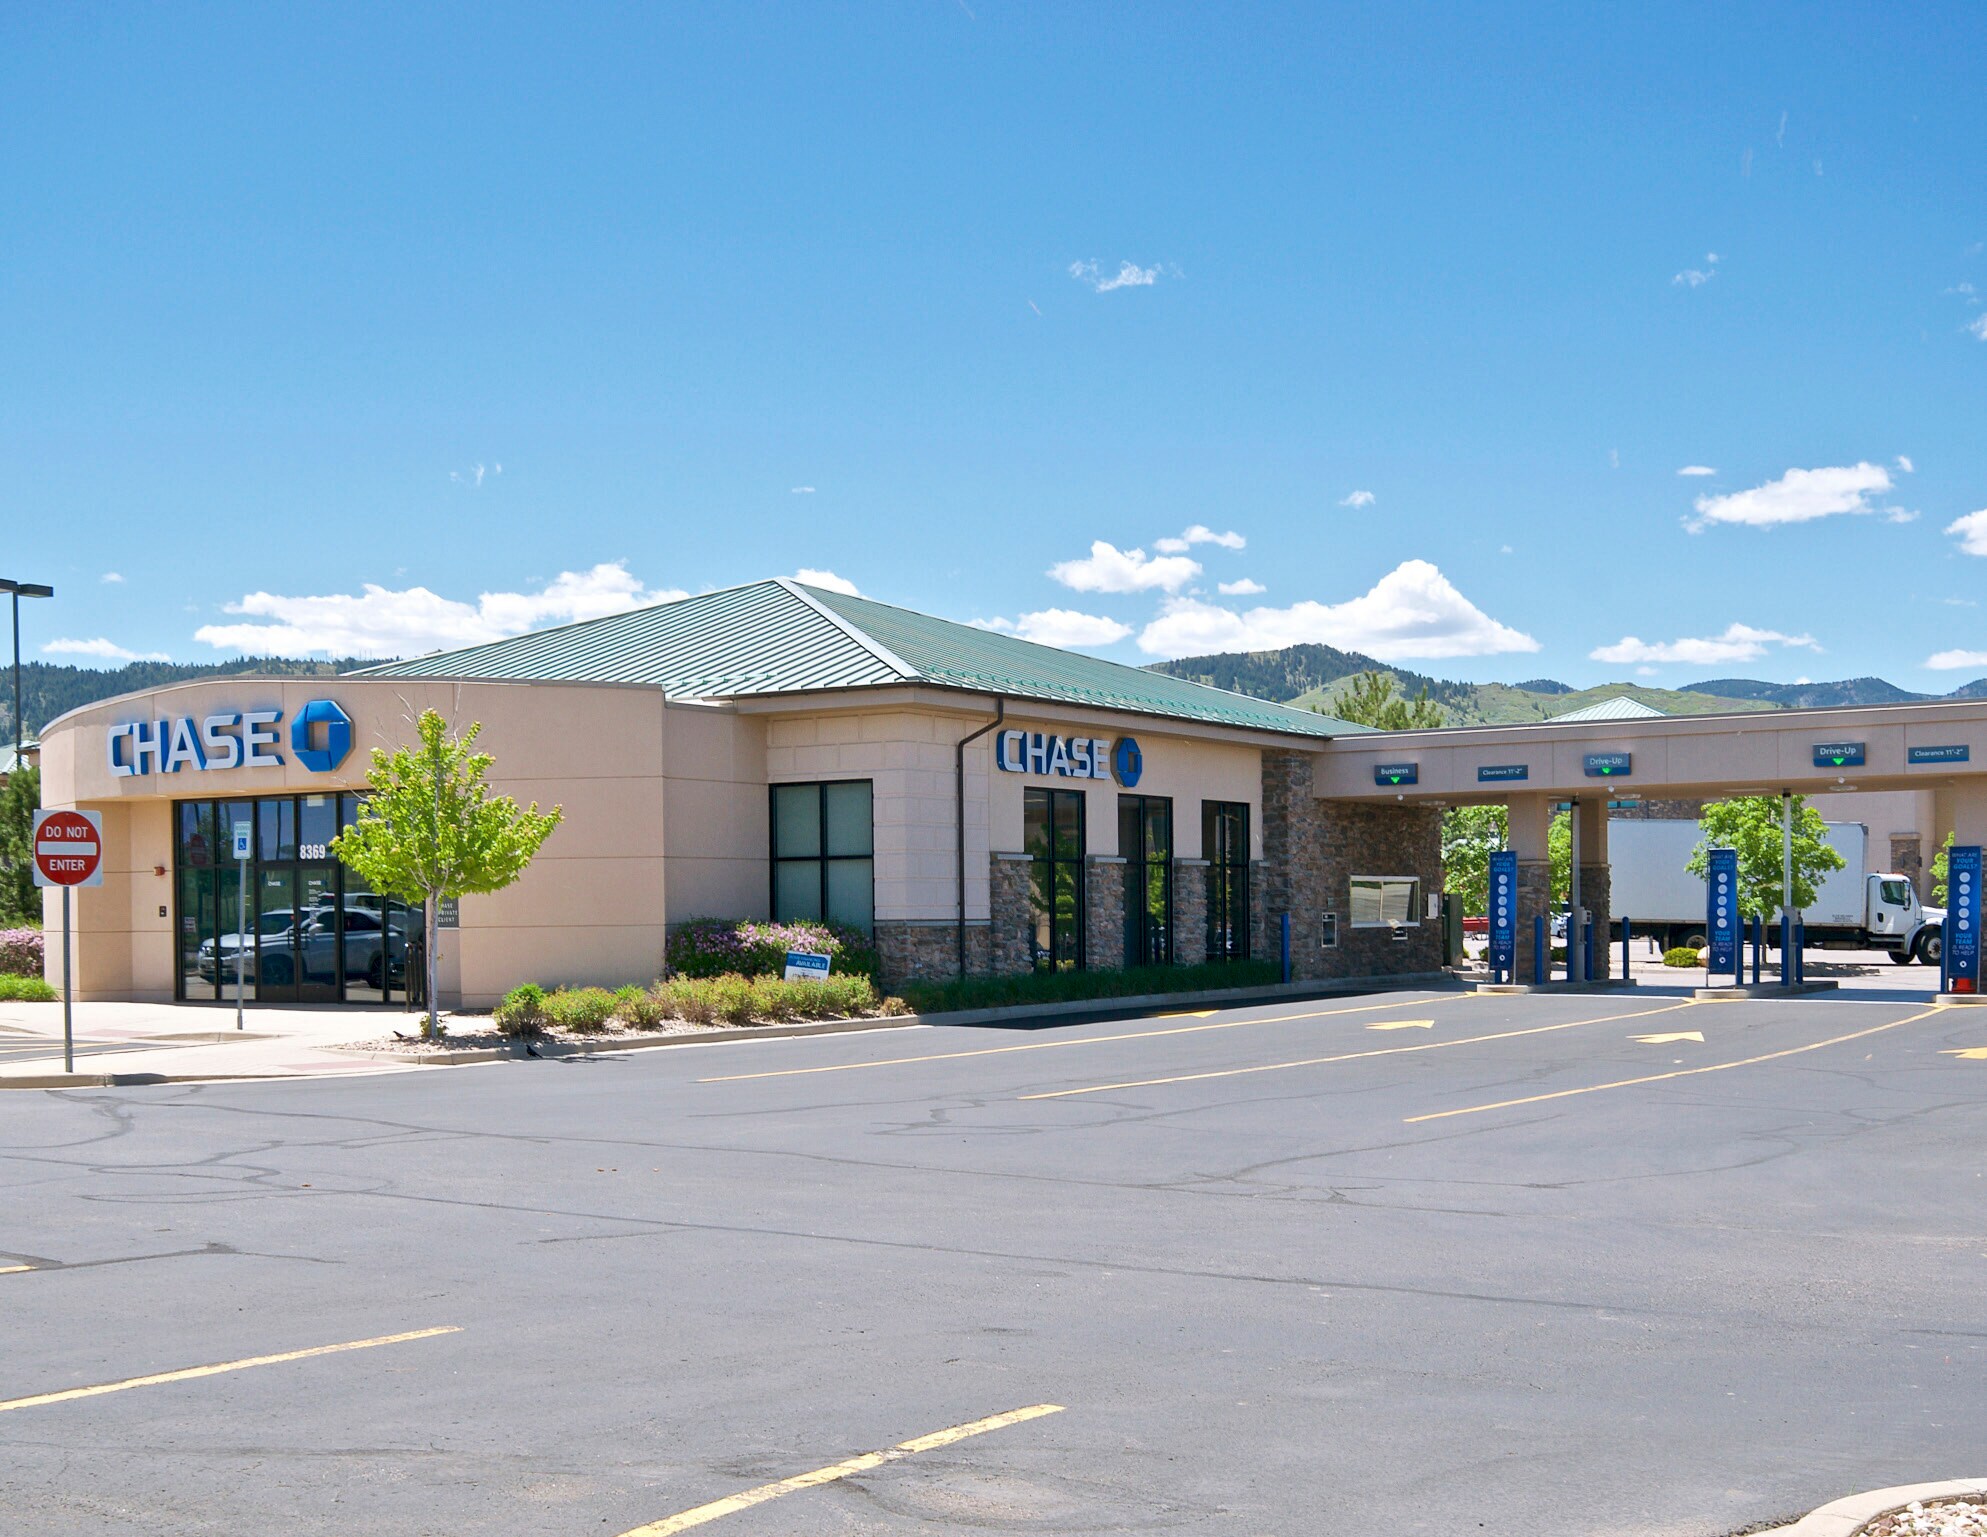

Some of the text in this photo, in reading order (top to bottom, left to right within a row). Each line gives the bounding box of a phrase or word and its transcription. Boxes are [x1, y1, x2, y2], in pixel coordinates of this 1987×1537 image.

[107, 711, 285, 777] CHASE
[997, 730, 1111, 780] CHASE
[1820, 747, 1856, 755] Drive-Up
[1380, 767, 1409, 775] Business
[1482, 768, 1507, 776] Clearance
[45, 825, 88, 839] DO NOT
[300, 844, 326, 860] 8369
[49, 859, 86, 871] ENTER
[795, 960, 826, 969] AVAILABLE
